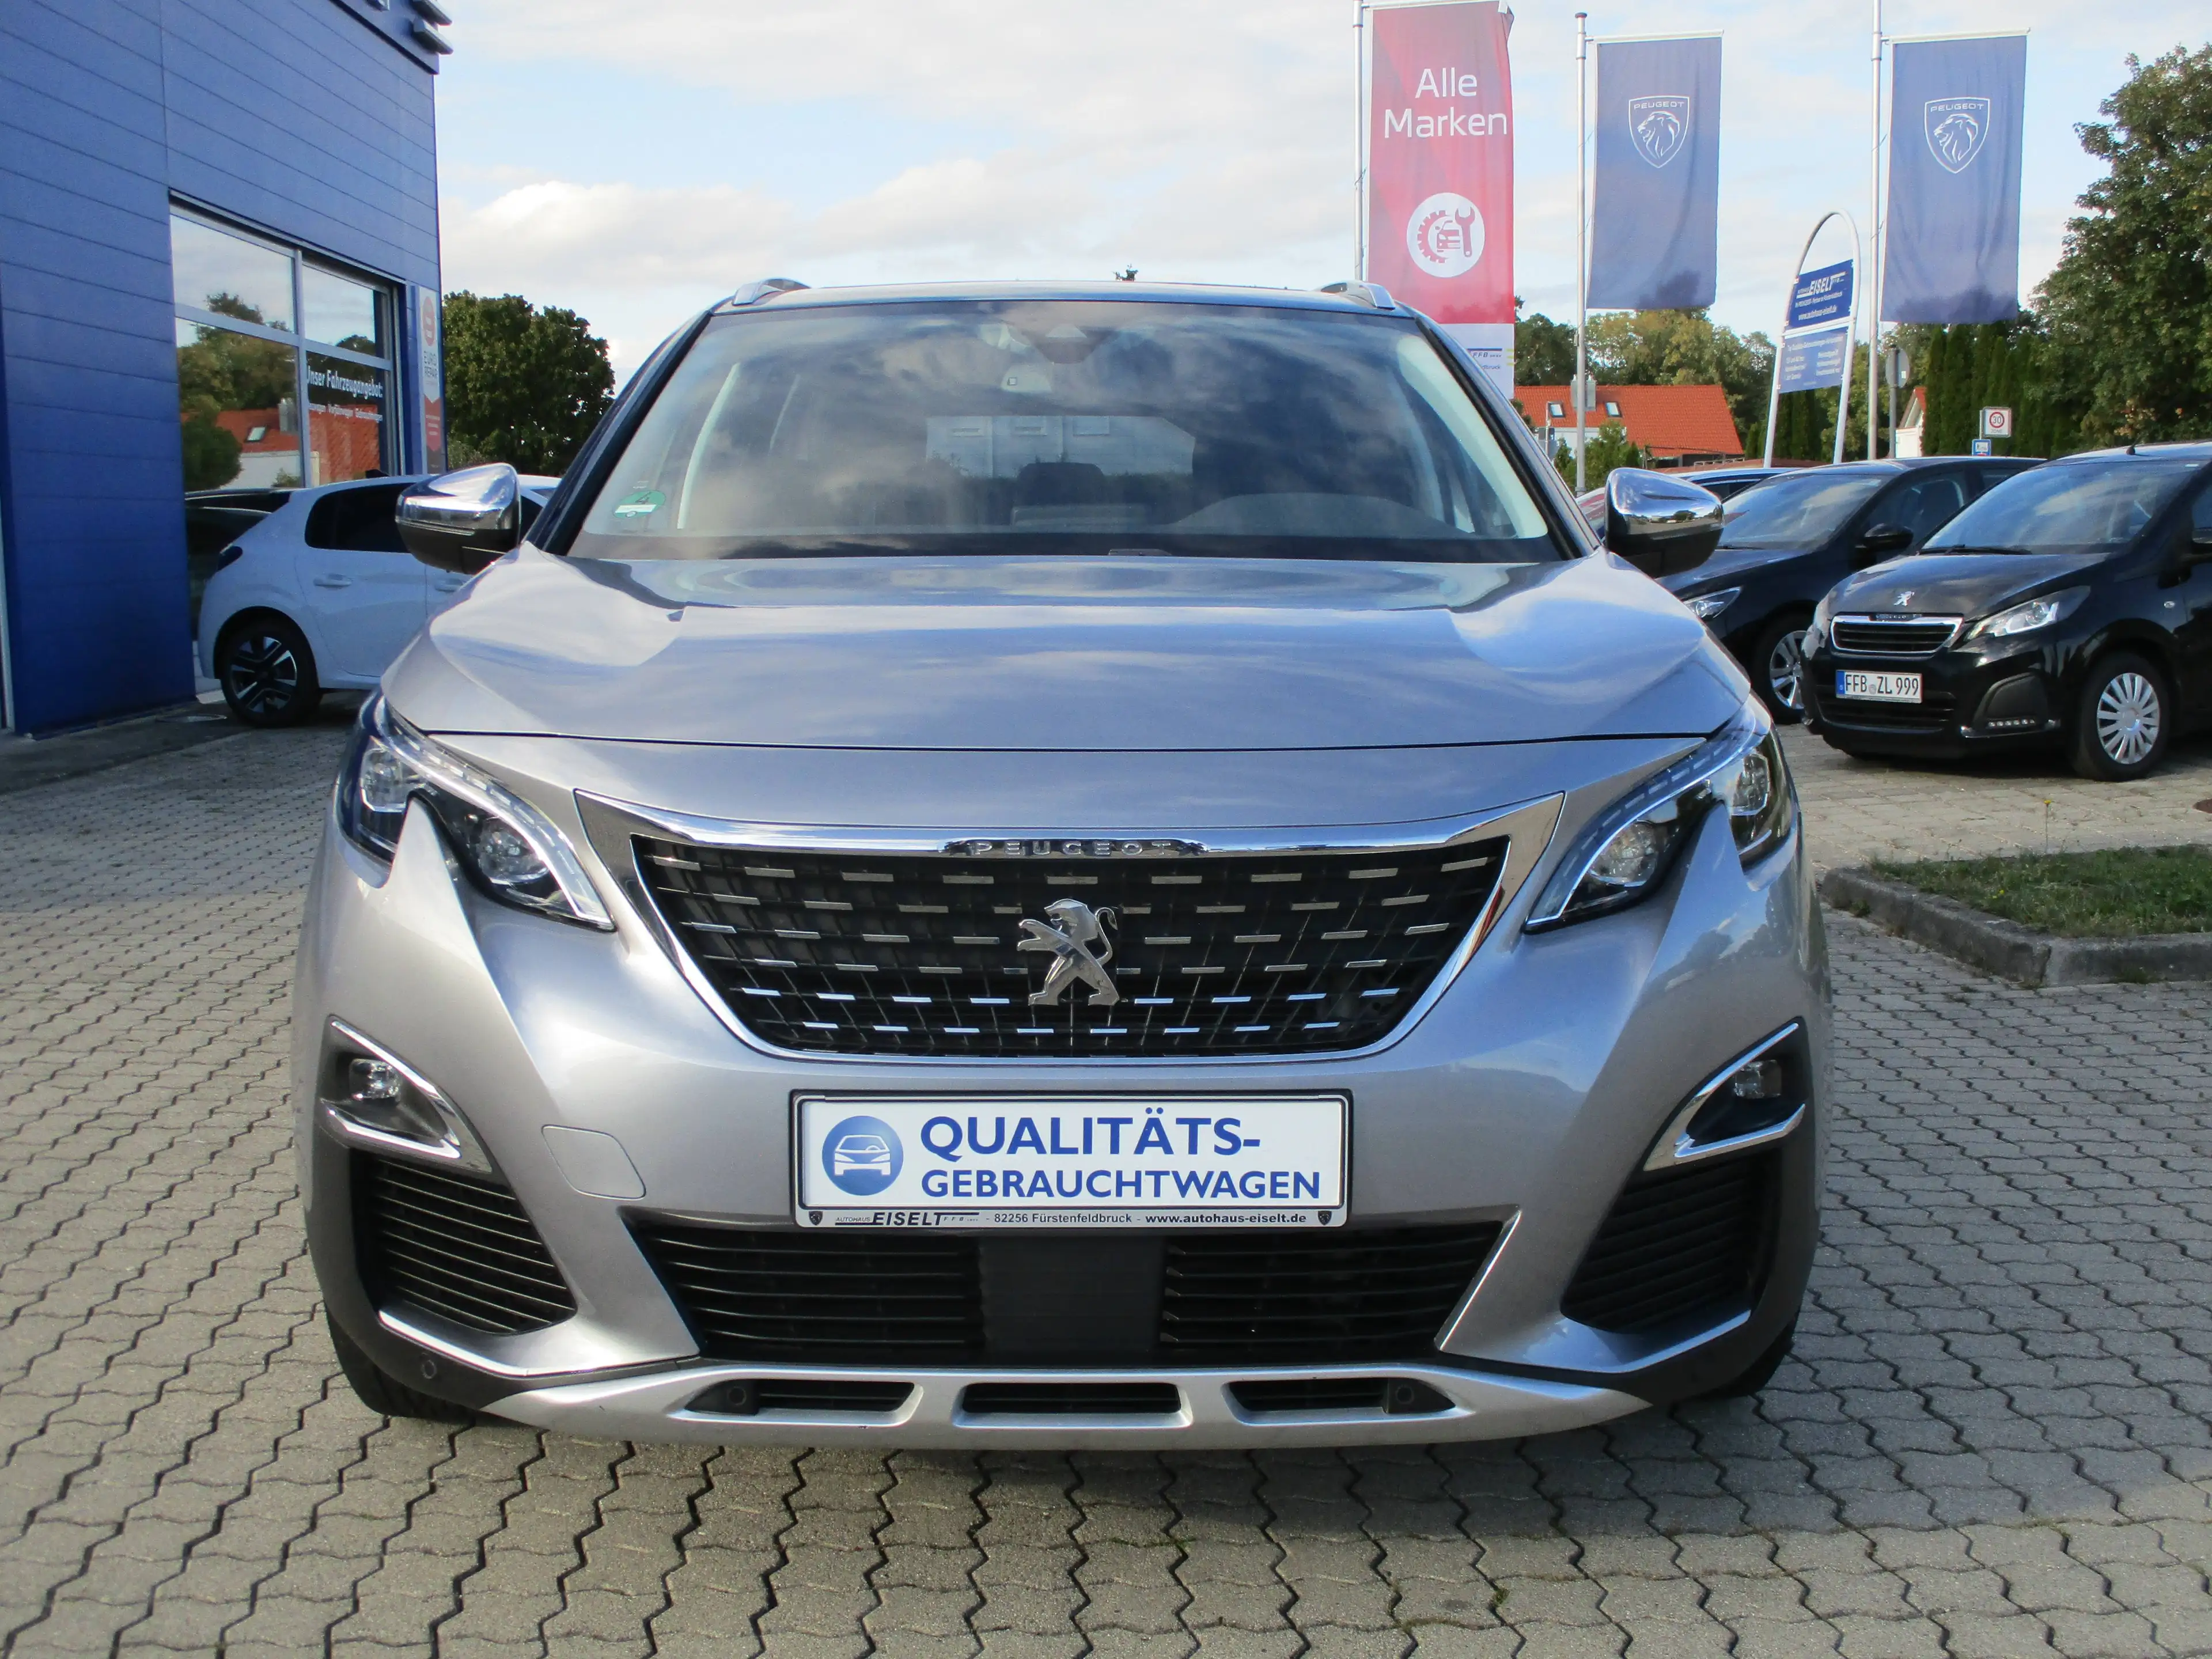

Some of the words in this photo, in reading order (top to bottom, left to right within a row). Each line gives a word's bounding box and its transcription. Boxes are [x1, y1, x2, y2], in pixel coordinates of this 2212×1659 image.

[1415, 67, 1478, 99] Alle
[1634, 101, 1685, 109] PEUGEOT
[1930, 103, 1984, 112] PEUGEOT
[1384, 107, 1508, 138] Marken
[1809, 276, 1834, 295] EISELT
[1993, 416, 2002, 424] 30
[1846, 675, 1867, 692] FFB
[1877, 676, 1892, 694] ZL
[1896, 677, 1919, 695] 999
[976, 840, 1171, 855] PEUGEOT
[921, 1107, 1260, 1162] QUALITÄTS-
[922, 1169, 1320, 1199] GEBRAUCHTWAGEN
[872, 1212, 943, 1226] EISELT
[994, 1214, 1028, 1222] 82256
[1032, 1213, 1132, 1222] Fürstenfeldbruck
[1145, 1213, 1306, 1223] www.autohaus-eiselt.de
